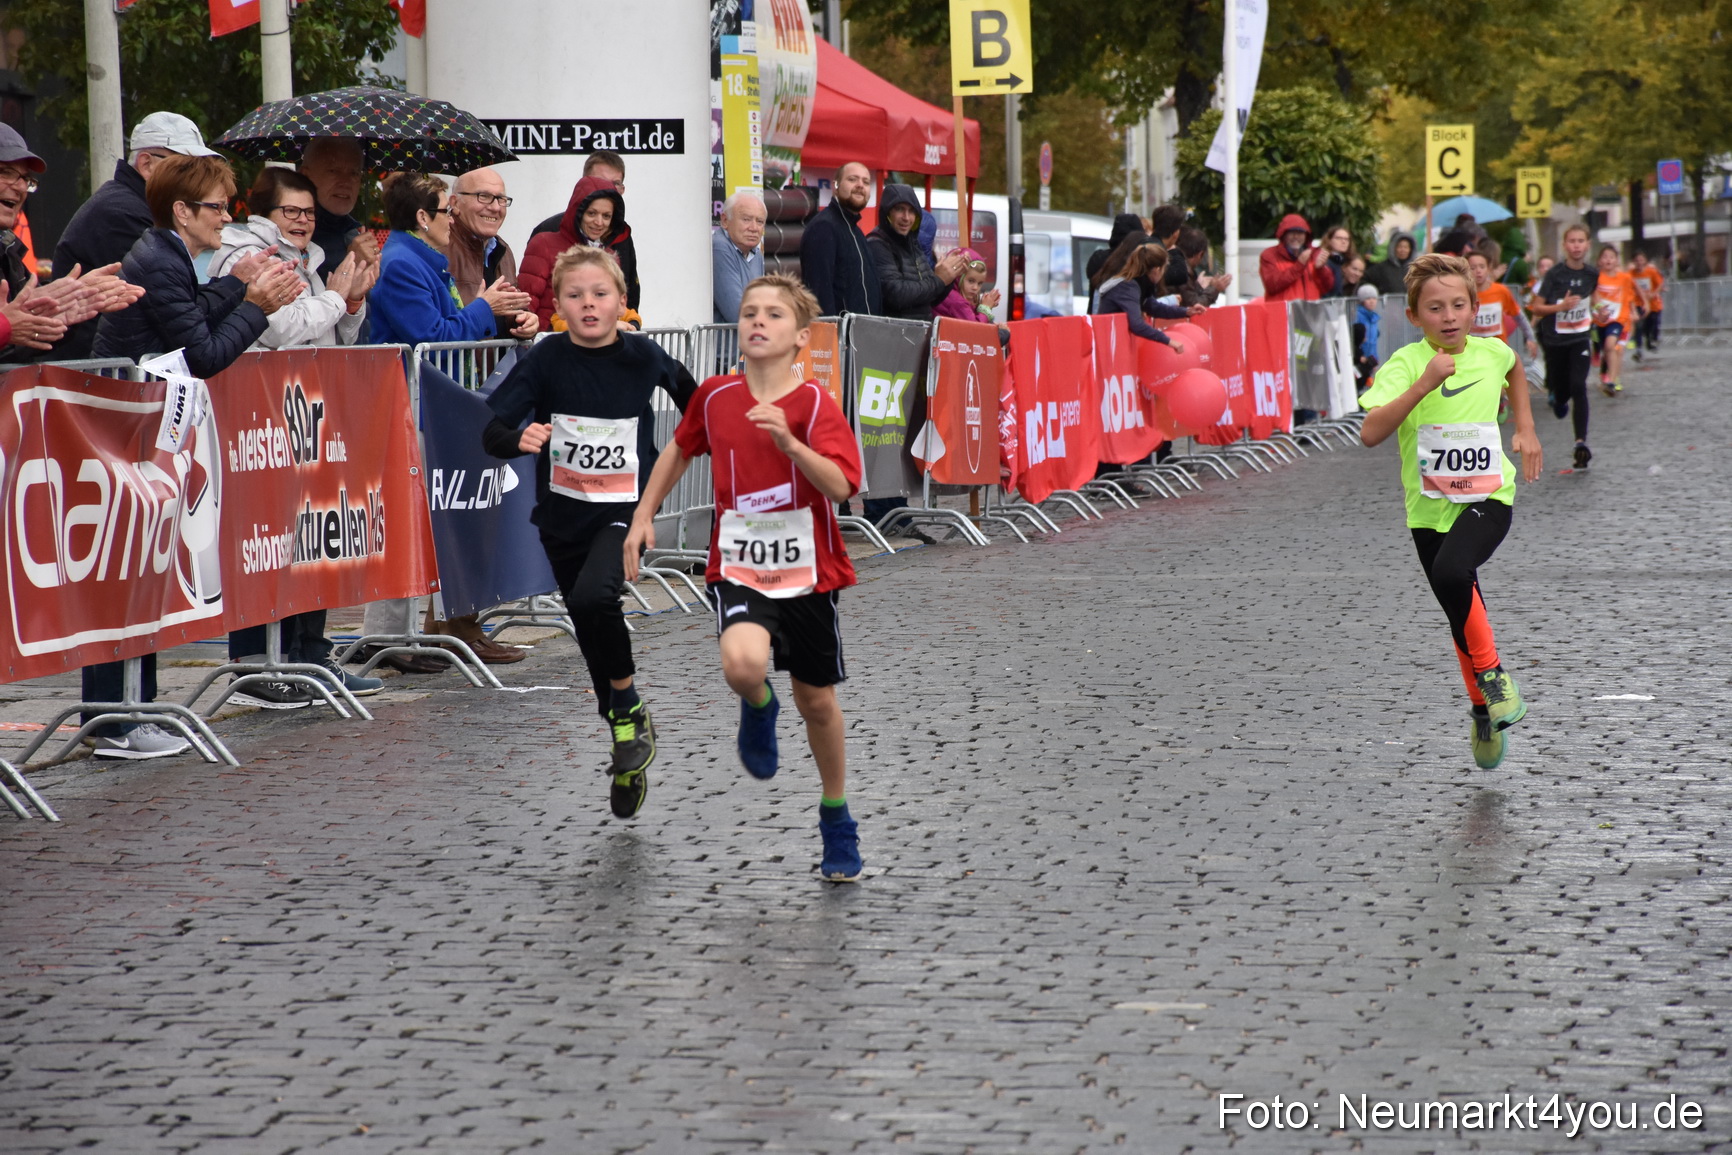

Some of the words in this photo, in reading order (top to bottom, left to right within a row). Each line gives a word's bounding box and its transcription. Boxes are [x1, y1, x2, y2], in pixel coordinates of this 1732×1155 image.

[971, 9, 1012, 68] B
[725, 74, 747, 96] 18.
[490, 123, 675, 150] MINI-Partl.de
[1432, 129, 1467, 142] Block
[1439, 147, 1461, 179] C
[1521, 170, 1547, 179] Block
[1526, 183, 1543, 206] D
[1563, 307, 1586, 320] 7102
[564, 441, 626, 469] 7323
[1431, 447, 1491, 472] 7099
[751, 494, 776, 507] DEHN
[733, 537, 800, 565] 7015
[755, 574, 782, 585] Julian
